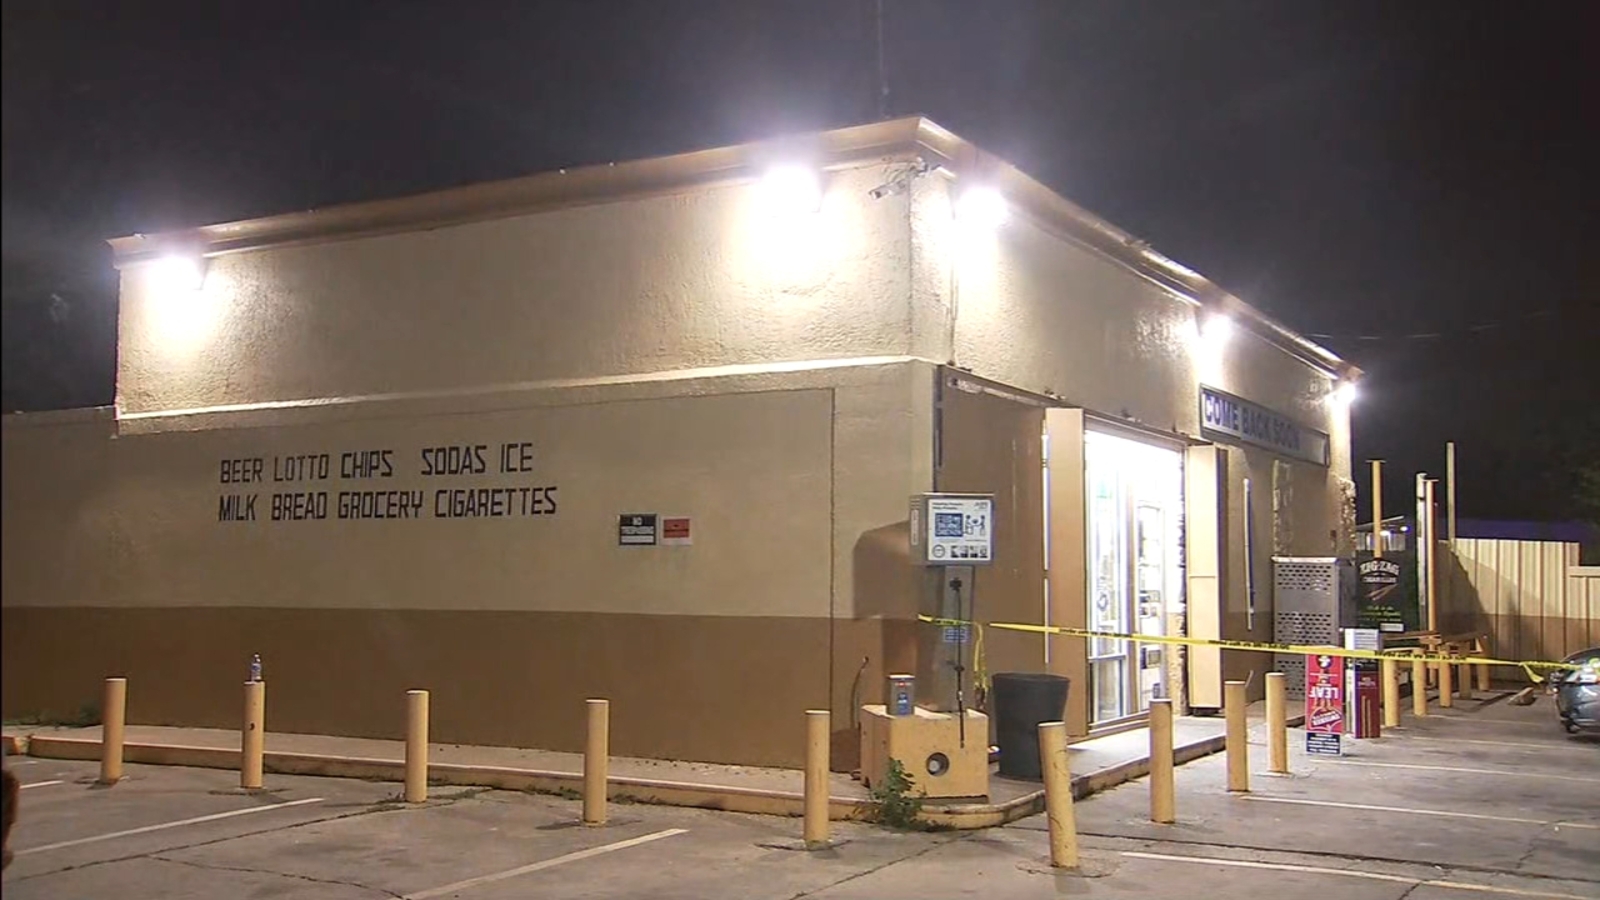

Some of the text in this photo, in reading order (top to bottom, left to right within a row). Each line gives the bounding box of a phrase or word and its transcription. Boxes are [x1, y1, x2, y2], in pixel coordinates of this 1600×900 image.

[1204, 393, 1239, 430] COME
[1242, 407, 1270, 443] BACK
[220, 443, 534, 483] BEER LOTTO CHIPS SODAS ICE
[219, 486, 558, 522] MILK BREAD GROCERY CIGARETTES
[1308, 686, 1340, 698] LEAF
